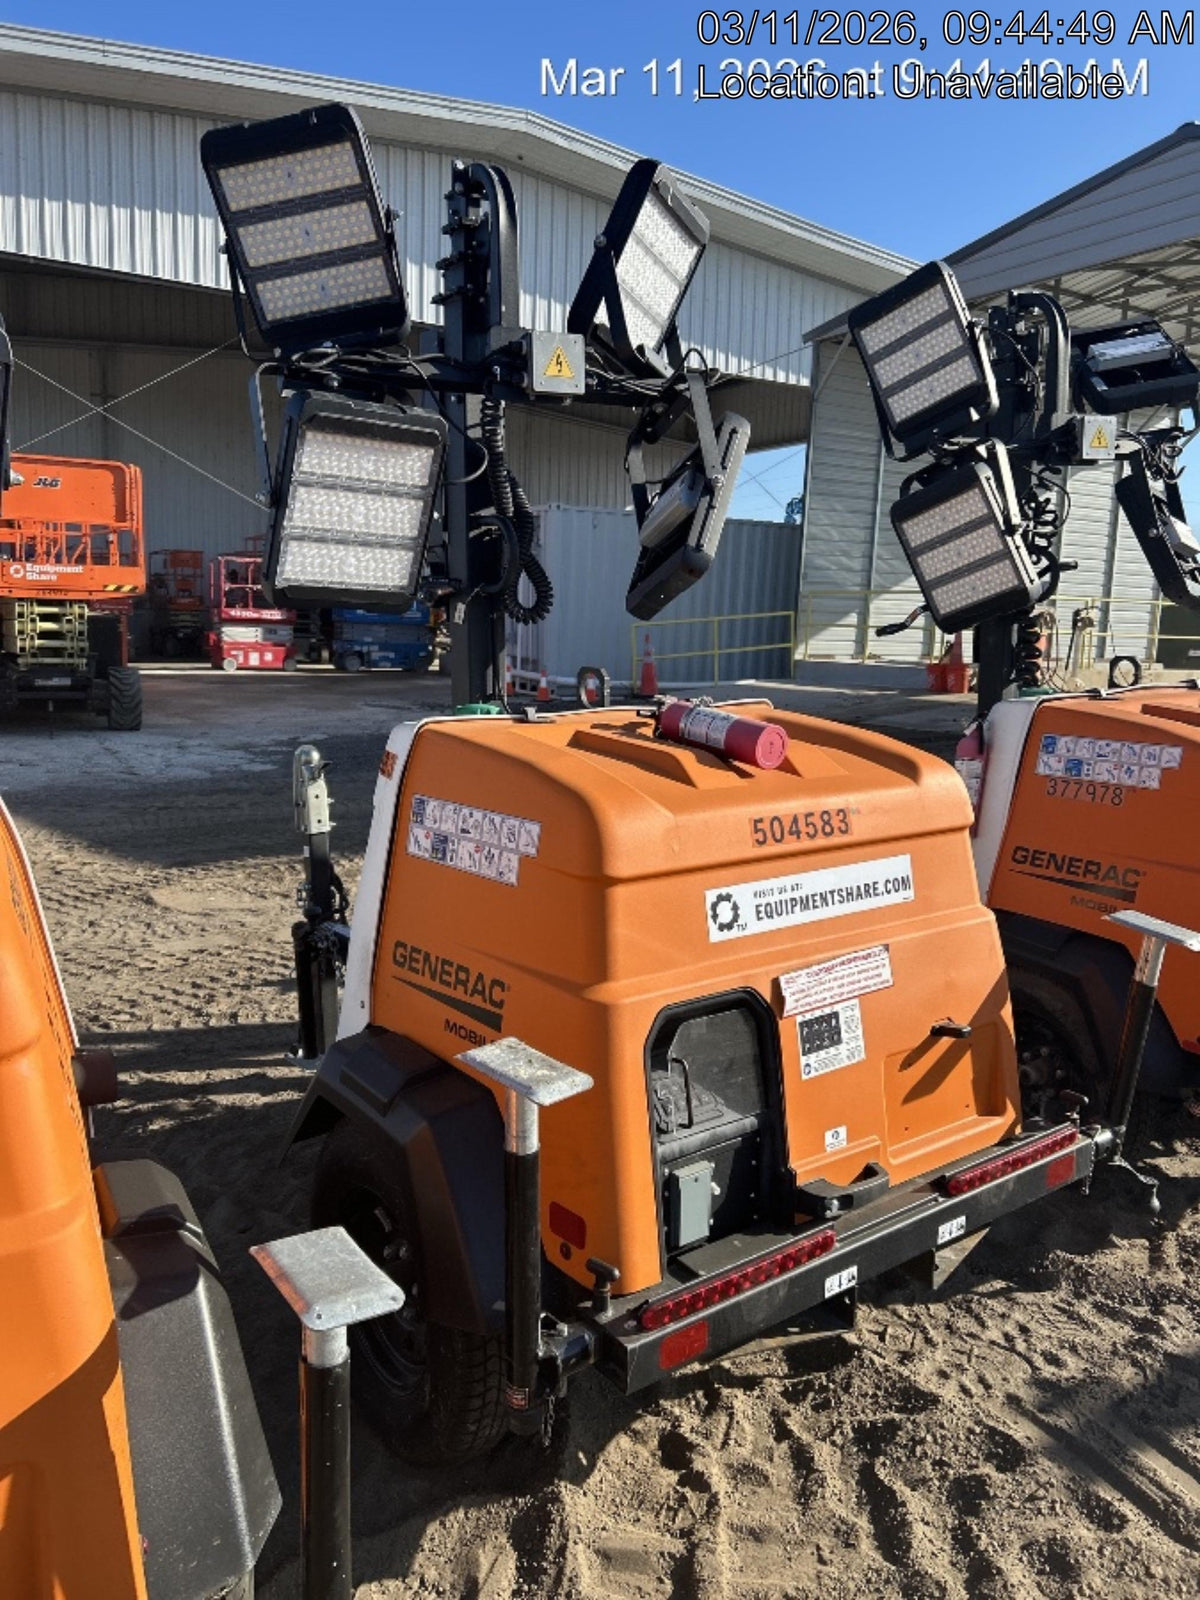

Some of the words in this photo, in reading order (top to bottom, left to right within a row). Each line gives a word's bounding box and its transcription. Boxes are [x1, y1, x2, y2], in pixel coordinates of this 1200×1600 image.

[26, 563, 84, 574] Equipment
[26, 572, 58, 581] Share
[1046, 778, 1123, 806] 377978
[753, 808, 849, 846] 504583
[1011, 845, 1140, 889] GENERAC
[755, 874, 911, 921] EQUIPMENTSHARE.COM
[393, 940, 506, 1010] GENERAC
